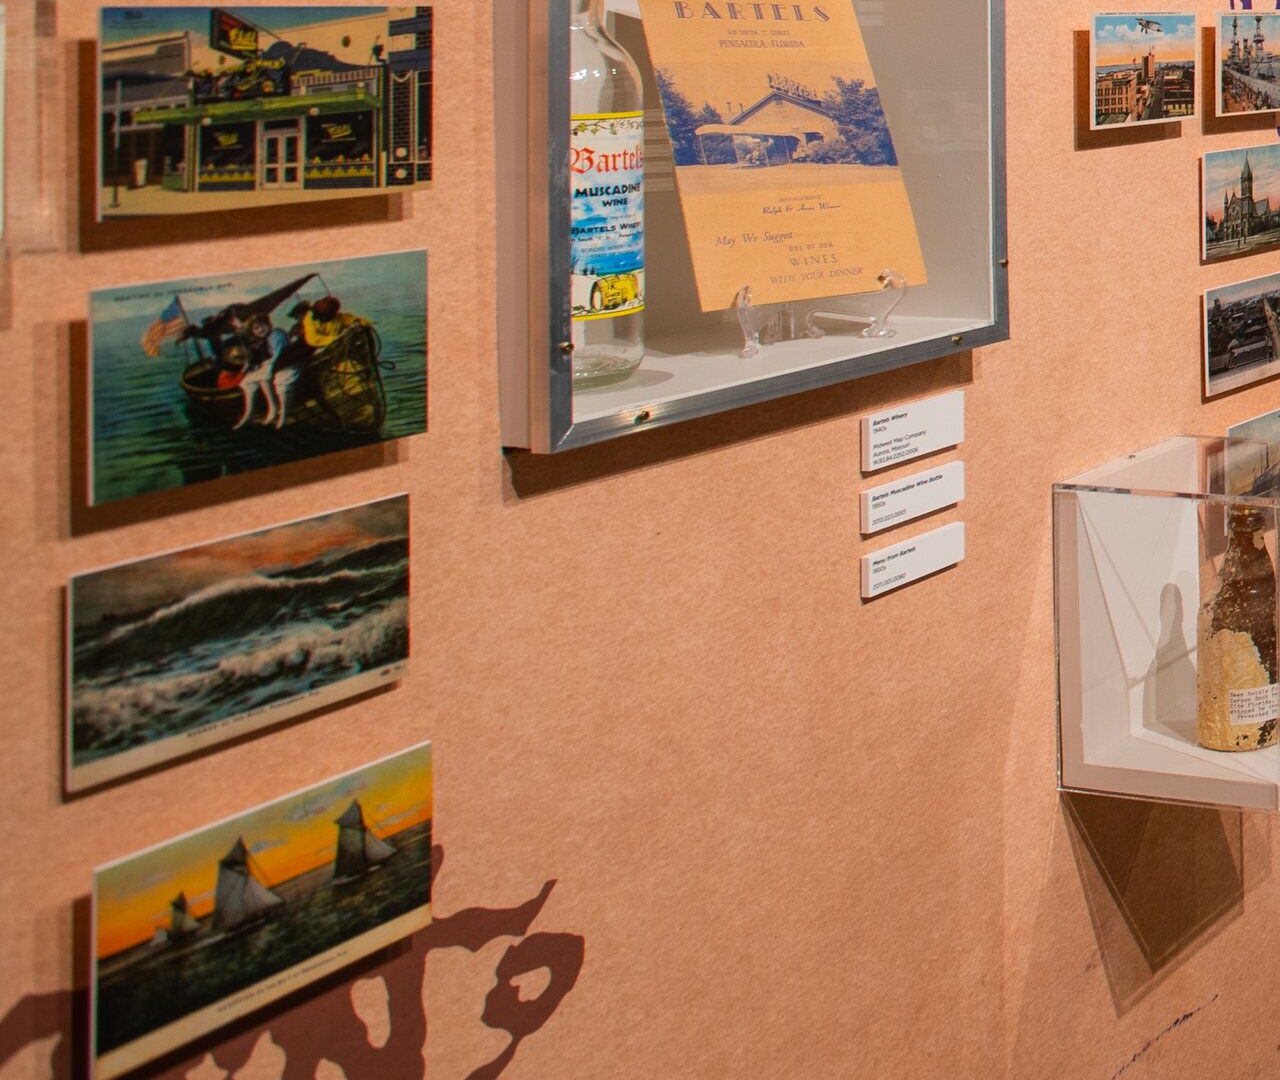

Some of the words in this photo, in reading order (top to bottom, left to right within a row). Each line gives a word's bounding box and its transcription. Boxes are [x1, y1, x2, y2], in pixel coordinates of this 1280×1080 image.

[673, 0, 830, 23] BARTELS
[770, 39, 806, 49] FLORIDA
[573, 182, 641, 199] MUSCADINE
[601, 197, 628, 208] WINE
[571, 224, 617, 236] BARTELS
[715, 235, 736, 248] May
[742, 232, 758, 244] We
[763, 230, 794, 244] Suggest
[788, 253, 838, 267] WINES
[770, 274, 796, 285] WITH
[800, 270, 825, 281] YOUR
[829, 266, 864, 279] DINNER
[890, 412, 909, 421] Winery
[904, 430, 927, 440] Company
[889, 483, 916, 496] Muscadine
[915, 479, 929, 487] Wine
[886, 553, 899, 561] from
